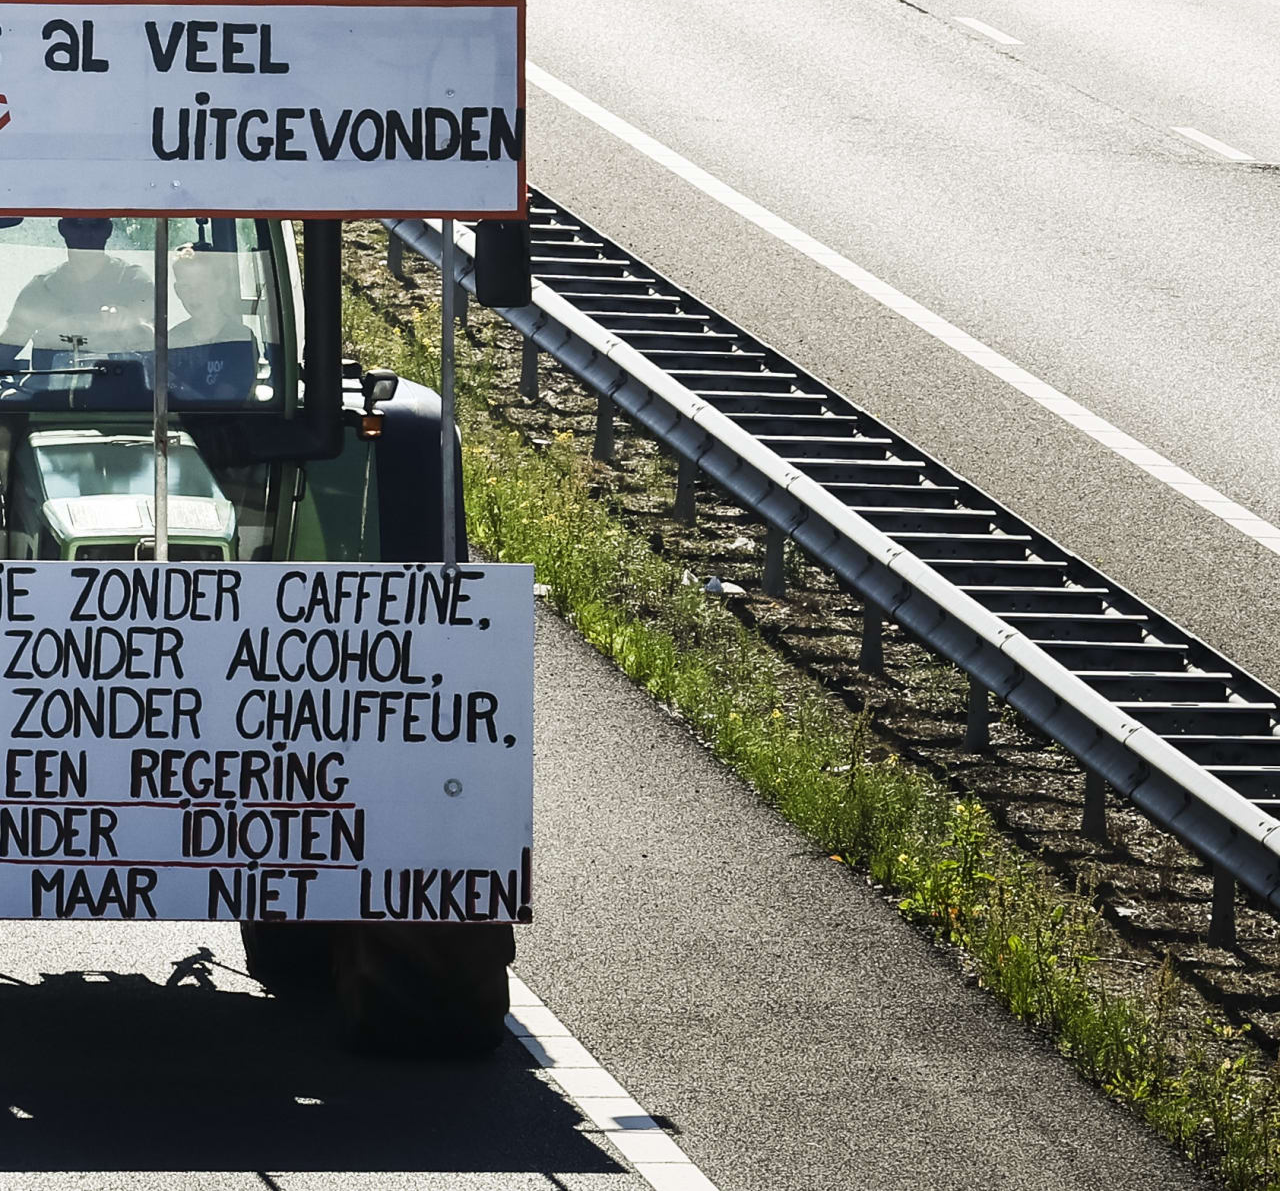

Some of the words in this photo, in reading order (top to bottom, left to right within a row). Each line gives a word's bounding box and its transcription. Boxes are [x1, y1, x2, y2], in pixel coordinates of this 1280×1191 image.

[144, 20, 290, 73] VEEL
[70, 567, 242, 621] ZONDER
[3, 626, 184, 680] ZONDER
[226, 626, 443, 687] ALCOHOL,
[11, 686, 202, 739] ZONDER
[236, 688, 516, 748] CHAUFFEUR,
[5, 749, 87, 798] EEN
[31, 867, 158, 918] MAAR
[360, 847, 533, 922] LUKKEN!
